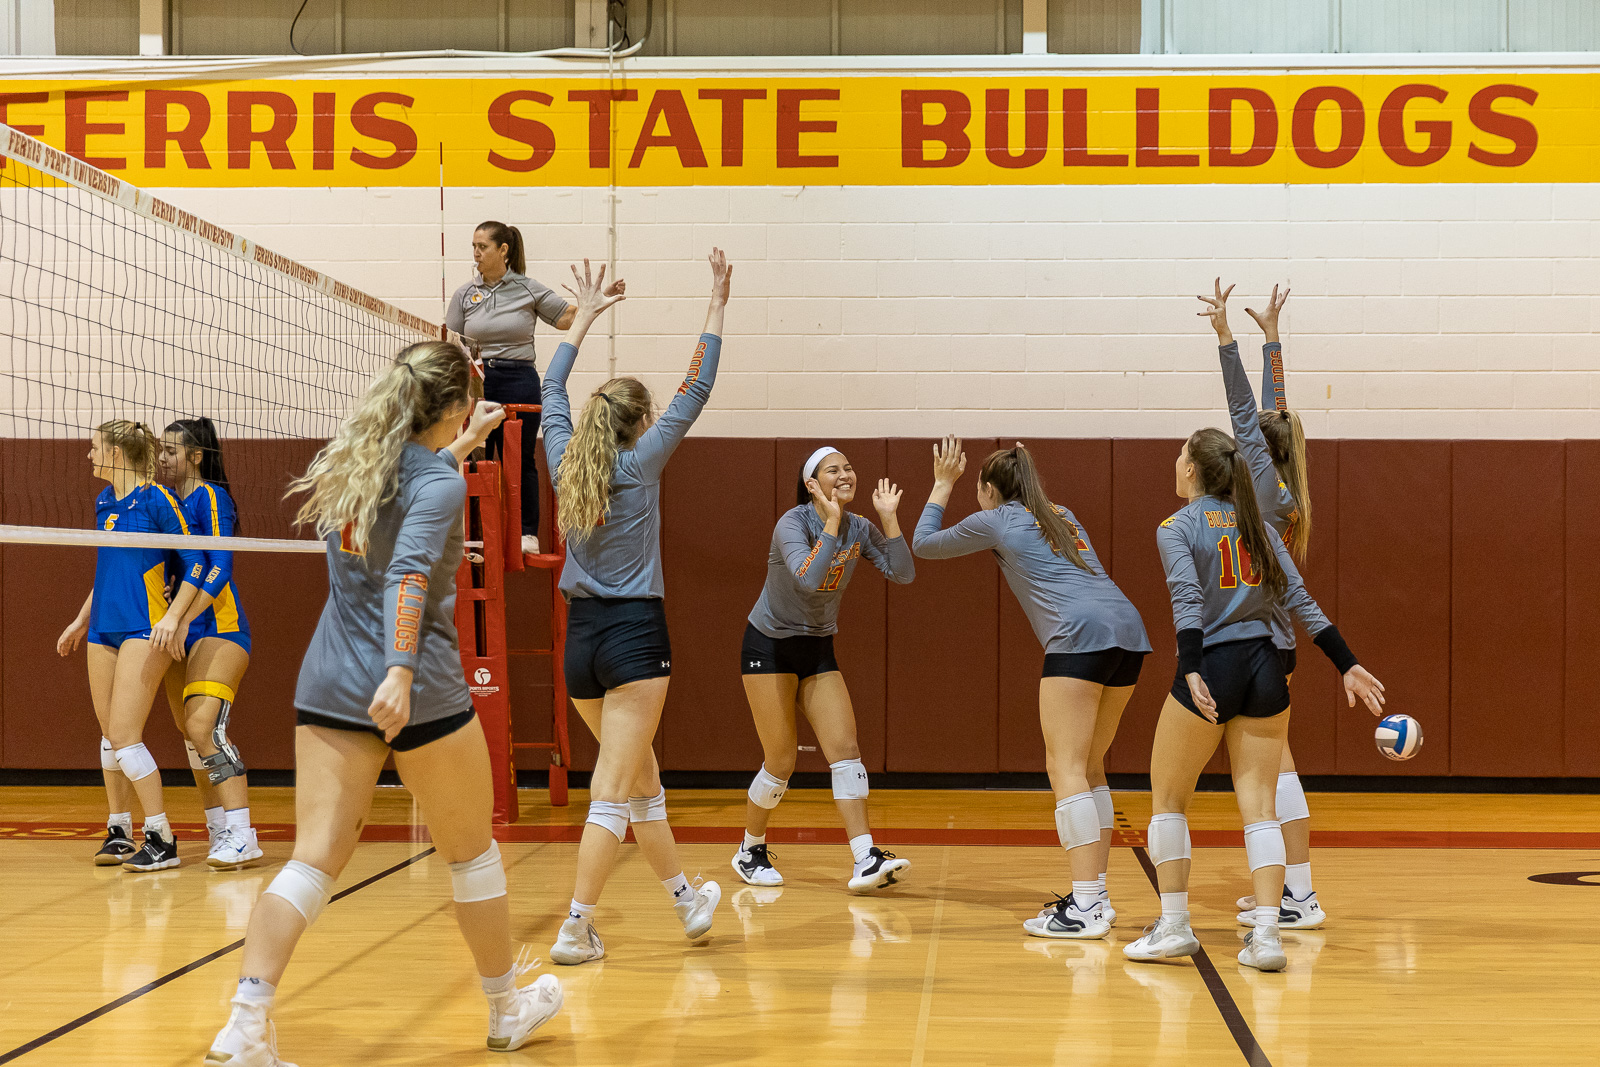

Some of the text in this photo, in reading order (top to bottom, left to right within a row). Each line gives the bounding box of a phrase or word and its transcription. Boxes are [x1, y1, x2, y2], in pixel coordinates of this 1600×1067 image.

[487, 89, 841, 172] STATE
[901, 83, 1539, 169] BULLDOGS
[8, 130, 121, 199] FERRIS STATE UNIVERSITY
[151, 197, 177, 224] FERRIS
[177, 208, 198, 235] STATE
[1204, 510, 1238, 528] BULL
